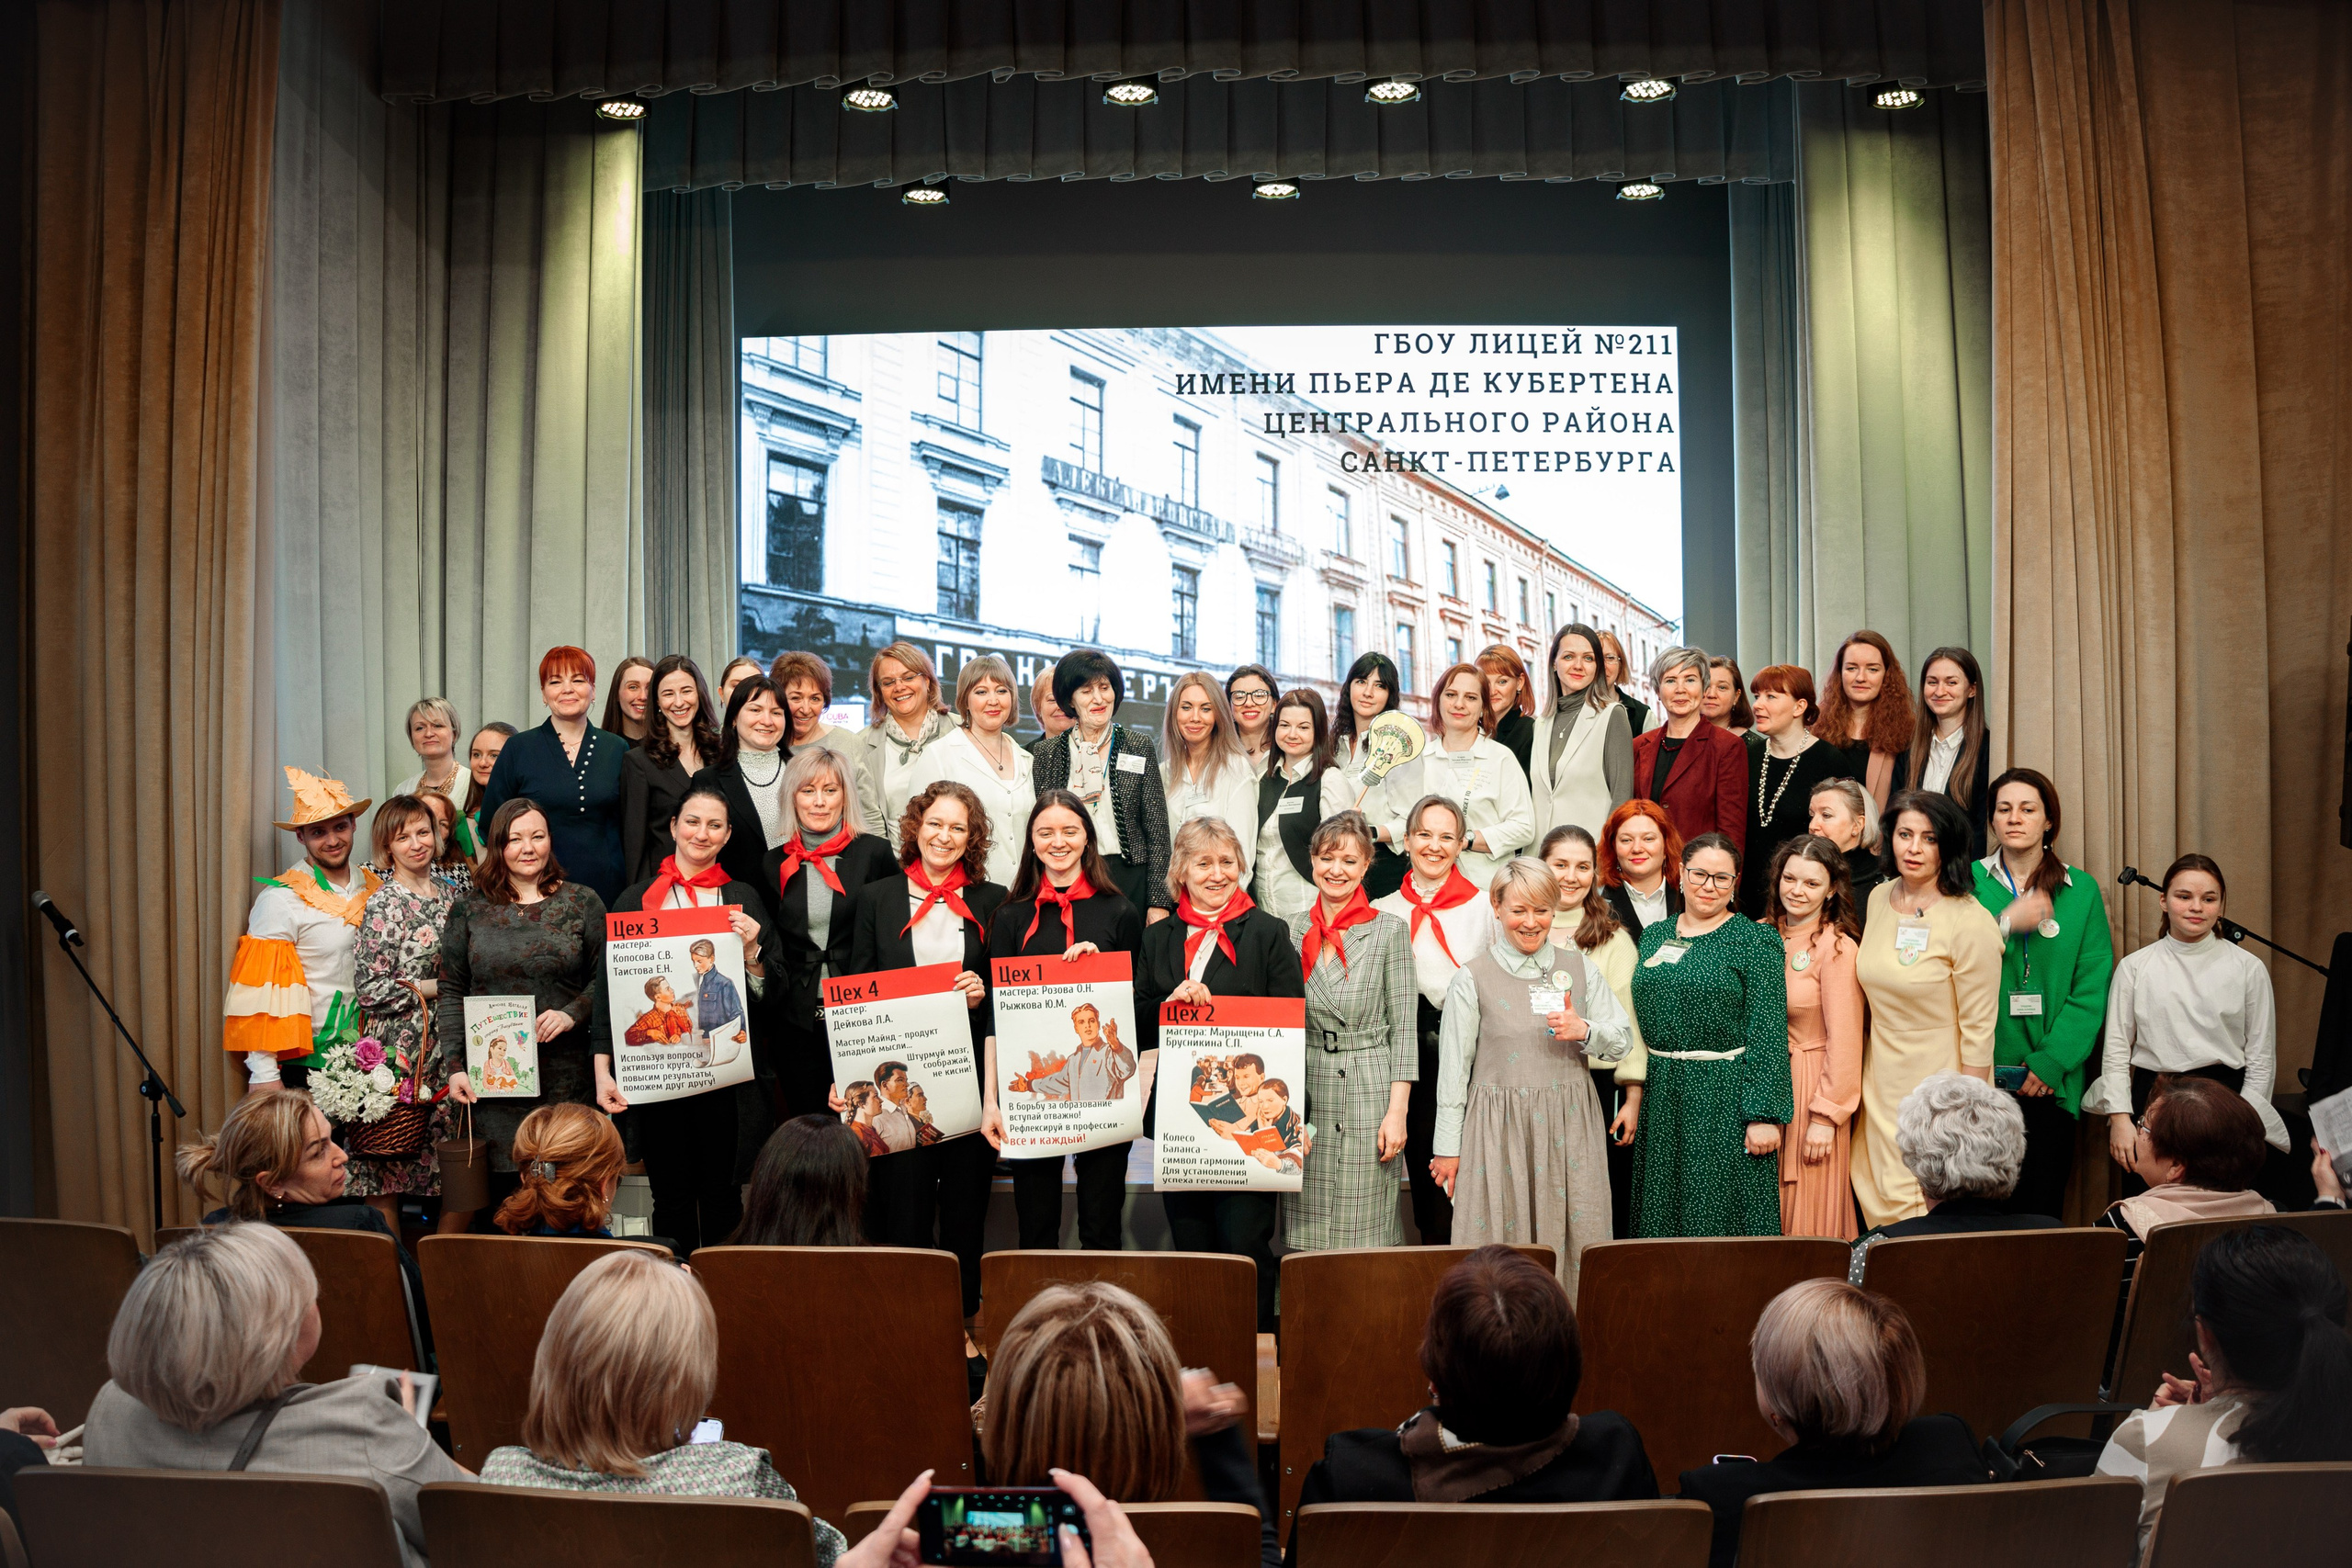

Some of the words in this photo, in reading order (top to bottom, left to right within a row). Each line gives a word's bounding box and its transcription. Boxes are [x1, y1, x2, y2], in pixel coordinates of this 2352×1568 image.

[1374, 333, 1455, 355] ГБОУ
[1469, 328, 1583, 358] ЛИЦЕЙ
[1595, 333, 1673, 355] №211
[1176, 373, 1296, 395] ИМЕНИ
[1309, 372, 1416, 394] ПЬЕРА
[1430, 372, 1470, 399] ДЕ
[1484, 372, 1674, 394] КУБЕРТЕНА
[1264, 412, 1530, 439] ЦЕНТРАЛЬНОГО
[1544, 406, 1675, 434] РАЙОНА
[1340, 451, 1675, 474] САНКТ-ПЕТЕРБУРГА
[614, 920, 644, 939] Цех
[650, 918, 659, 934] 3
[613, 940, 652, 951] мастера:
[613, 953, 655, 964] Копосова
[657, 951, 673, 961] С.В.
[614, 965, 653, 976] Таистова
[656, 964, 673, 975] Е.Н.
[999, 965, 1031, 985] Цех
[1036, 964, 1043, 981] 1
[830, 986, 863, 1005] Цех
[868, 980, 879, 998] 4
[999, 987, 1039, 998] мастера:
[1042, 985, 1074, 995] Розова
[1076, 983, 1094, 993] О.Н.
[831, 1005, 867, 1017] мастер:
[1000, 1000, 1043, 1011] Рыжкова
[1045, 998, 1067, 1009] Ю.М.
[1166, 1006, 1199, 1024] Цех
[1204, 1004, 1215, 1021] 2
[833, 1017, 873, 1032] Дейкова
[876, 1014, 893, 1024] Л.А.
[835, 1037, 865, 1048] Мастер
[867, 1033, 897, 1044] Майнд
[904, 1027, 939, 1040] продукт
[1166, 1028, 1207, 1037] мастера:
[1267, 1027, 1284, 1038] С.А.
[1166, 1038, 1223, 1049] Брусникина
[1226, 1038, 1243, 1048] С.П.
[620, 1053, 665, 1064] Используя
[667, 1050, 704, 1061] вопросы
[837, 1045, 876, 1058] западной
[906, 1049, 945, 1062] Штурмуй
[621, 1062, 664, 1072] активного
[667, 1061, 693, 1071] круга,
[922, 1056, 971, 1070] соображай,
[622, 1073, 661, 1082] повысим
[662, 1070, 714, 1082] результаты,
[933, 1069, 943, 1077] не
[944, 1065, 972, 1076] кисни!
[623, 1082, 663, 1092] поможем
[665, 1080, 685, 1091] друг
[688, 1078, 717, 1089] другу!
[1008, 1102, 1014, 1111] В
[1016, 1100, 1046, 1111] борьбу
[1047, 1101, 1057, 1110] за
[1058, 1100, 1113, 1110] образование
[1009, 1111, 1042, 1122] вступай
[1043, 1111, 1081, 1120] отважно!
[1010, 1122, 1063, 1134] Рефлексируй
[1072, 1122, 1118, 1132] профессии
[1010, 1137, 1027, 1145] все
[1030, 1136, 1036, 1145] и
[1039, 1134, 1086, 1146] каждый!
[1163, 1133, 1195, 1142] Колесо
[1163, 1144, 1201, 1154] Баланса
[1162, 1156, 1197, 1165] символ
[1200, 1158, 1245, 1167] гармонии
[1162, 1167, 1180, 1175] Для
[1183, 1168, 1247, 1177] установления
[1162, 1177, 1193, 1185] успеха
